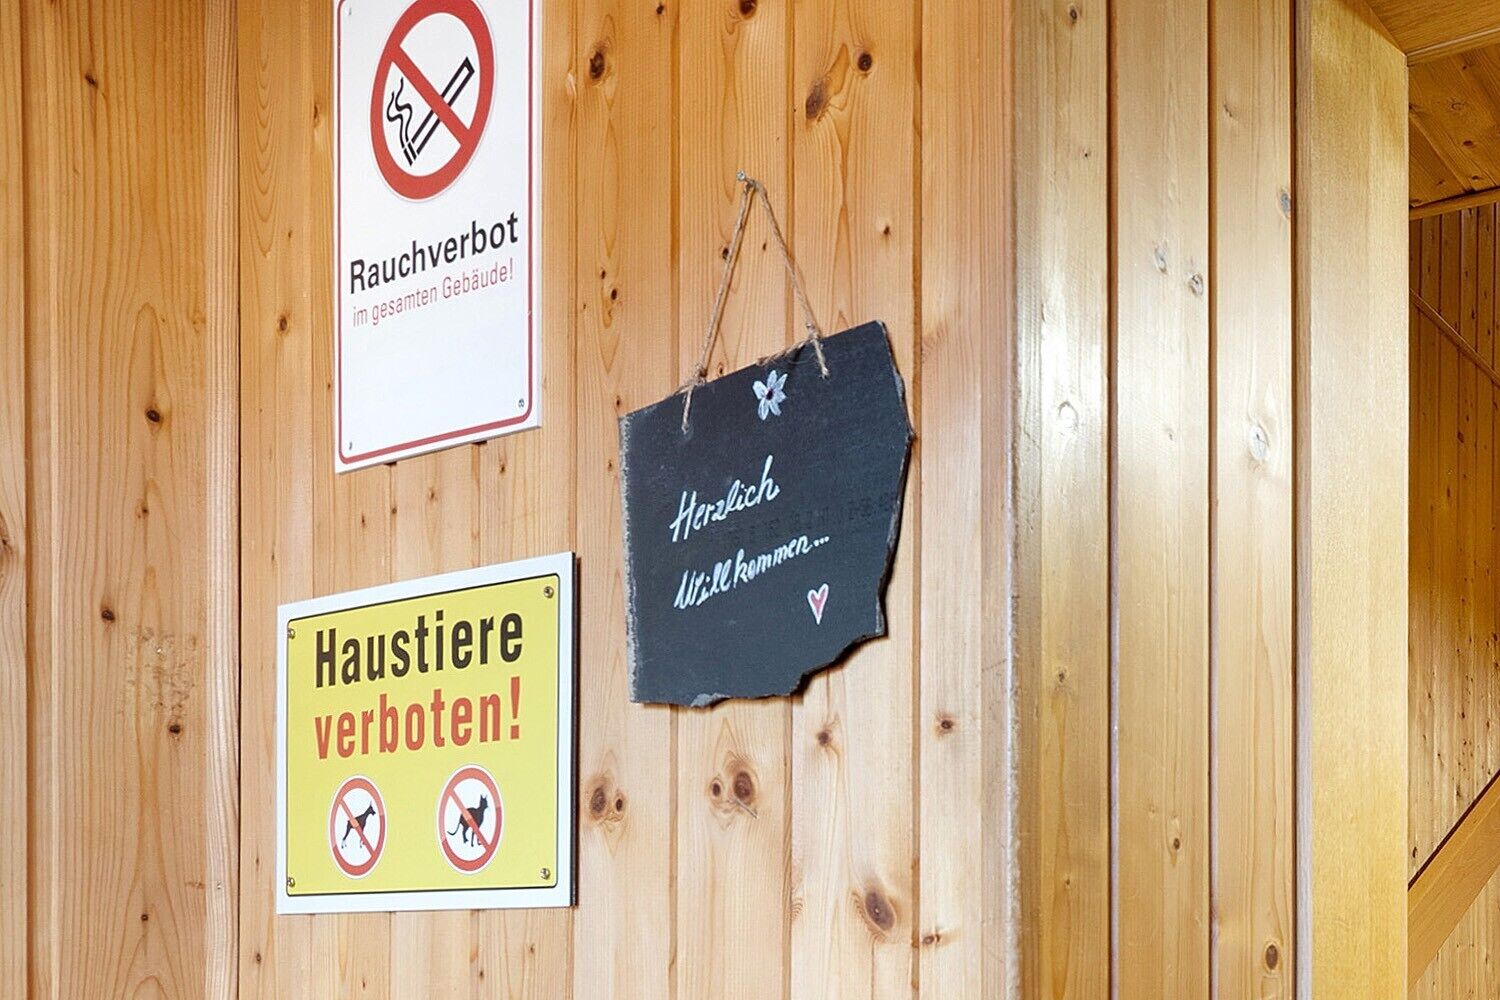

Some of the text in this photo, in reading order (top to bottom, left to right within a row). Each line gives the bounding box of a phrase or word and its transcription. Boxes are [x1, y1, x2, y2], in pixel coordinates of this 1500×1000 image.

[350, 212, 519, 294] Rauchverbot
[352, 257, 513, 327] im gesamten Gebäude!
[670, 455, 780, 542] Herzlich
[316, 609, 523, 688] Haustiere
[315, 676, 520, 760] verboten!
